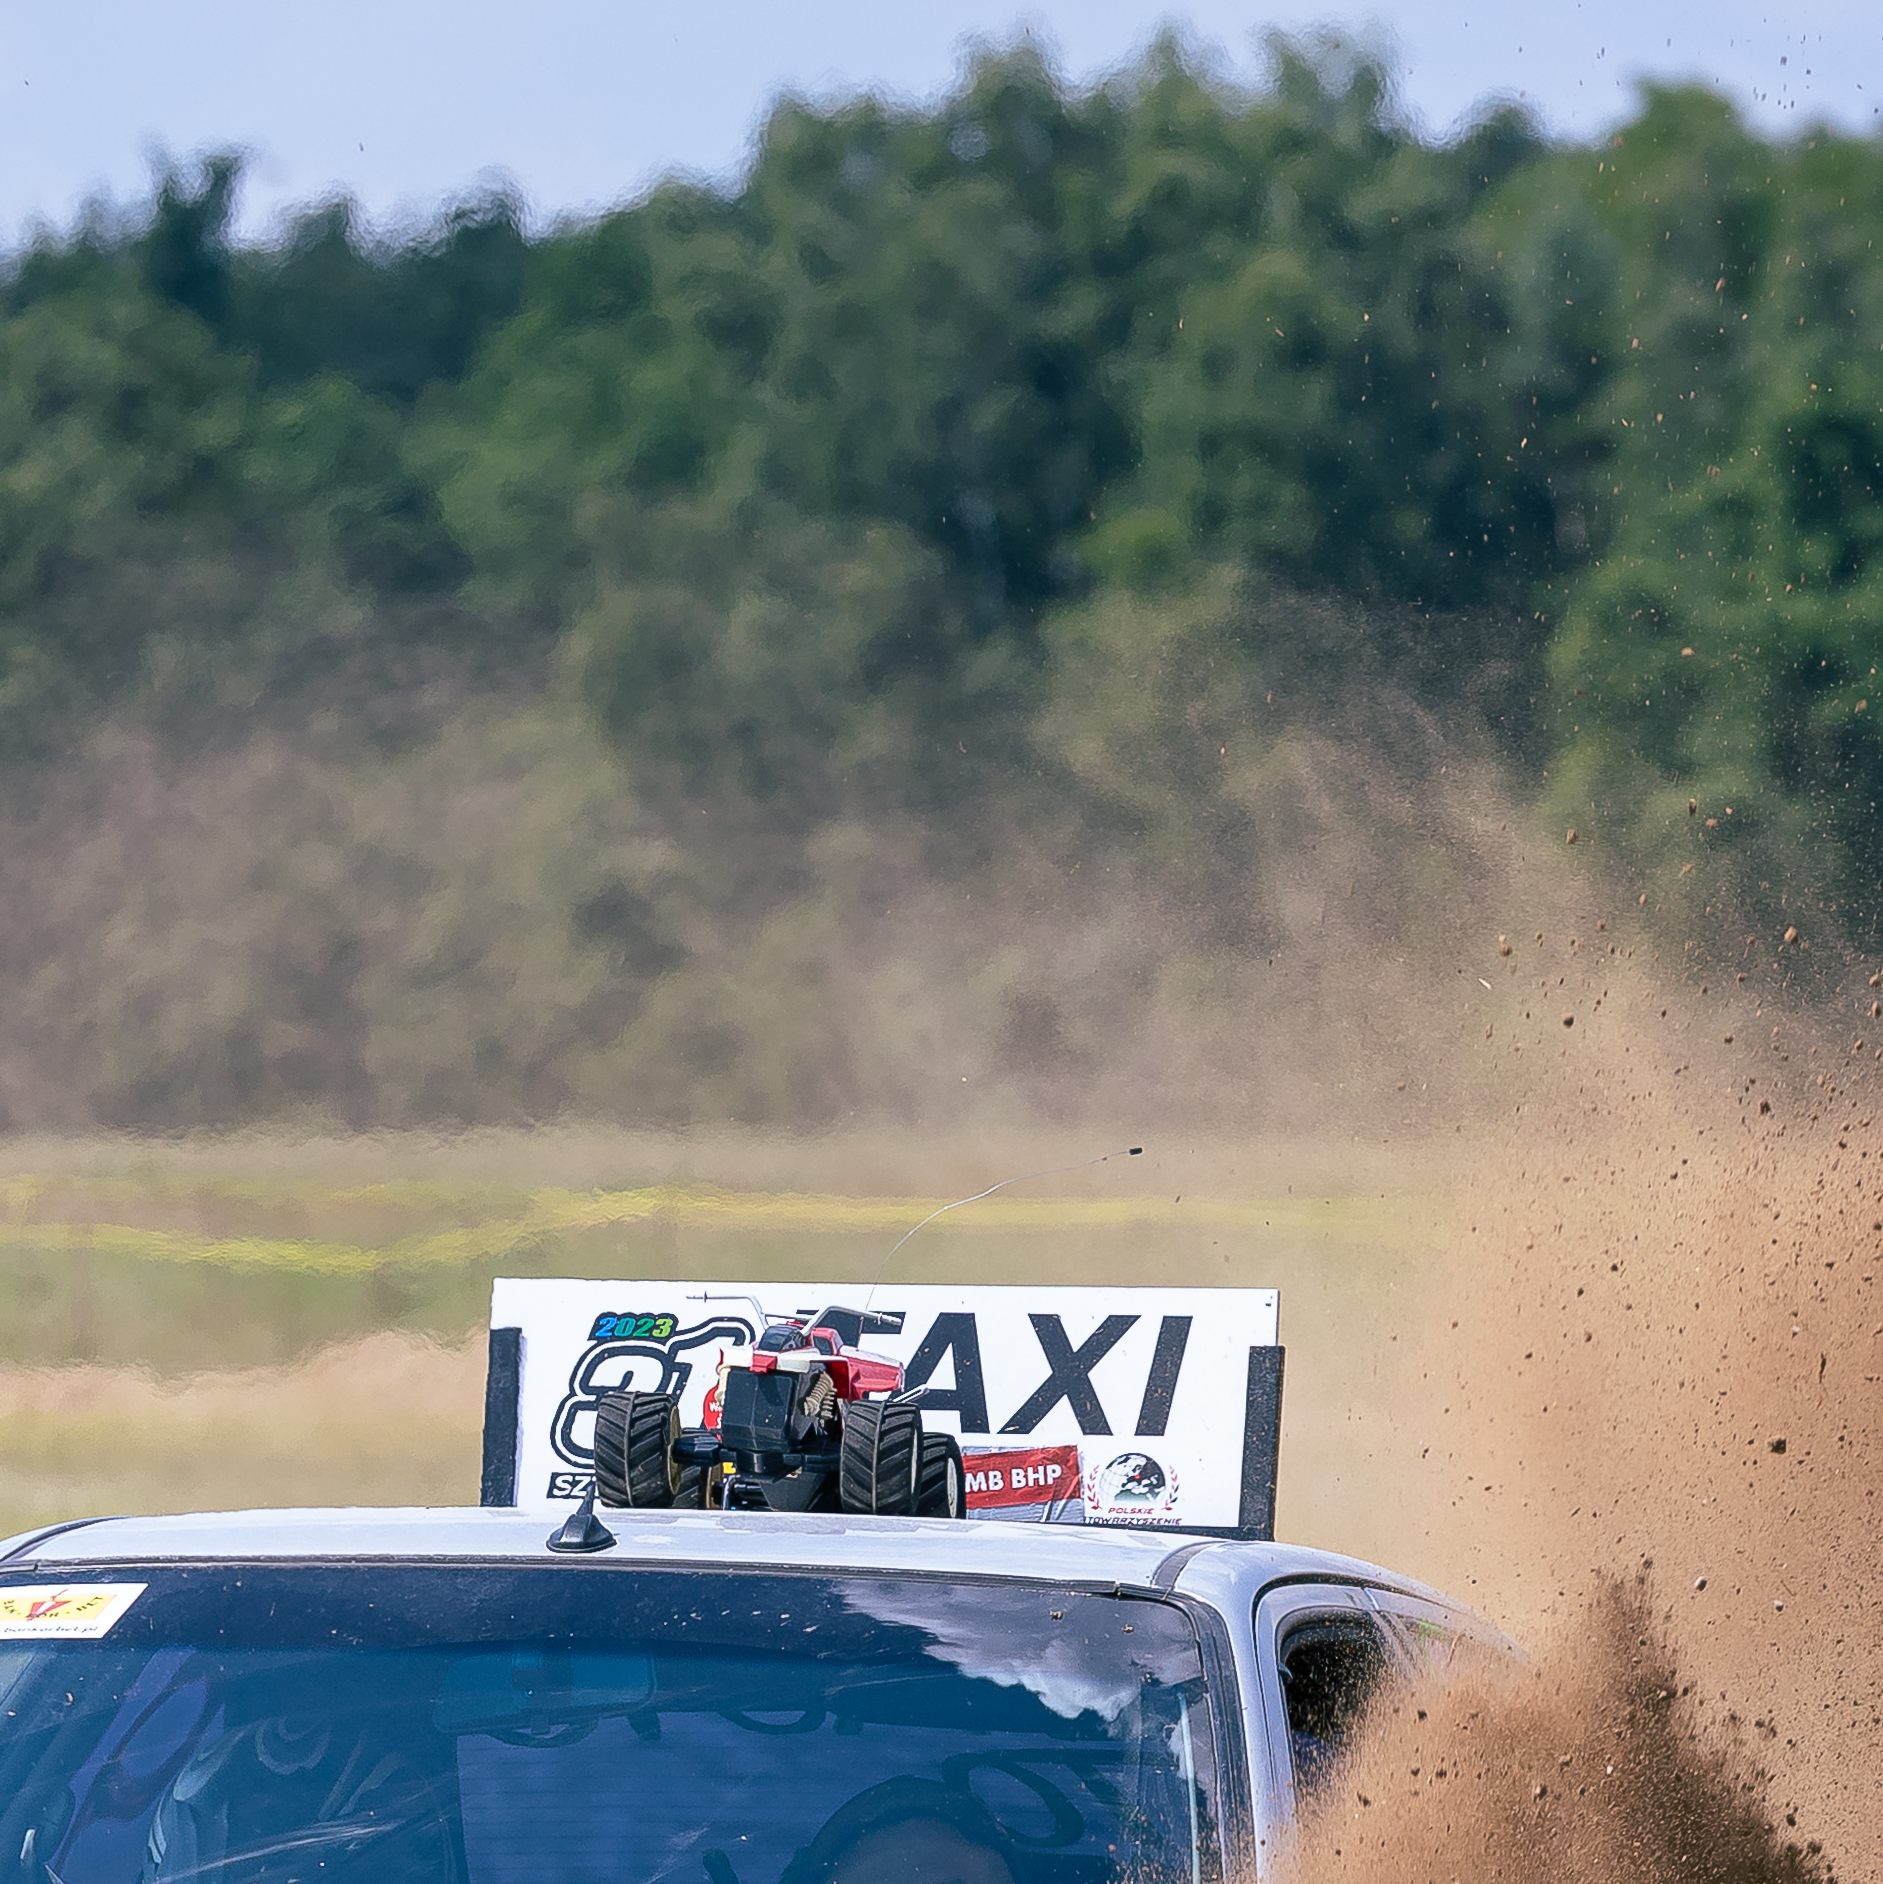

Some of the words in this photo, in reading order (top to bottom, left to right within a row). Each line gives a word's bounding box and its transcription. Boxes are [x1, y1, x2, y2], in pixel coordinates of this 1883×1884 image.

[594, 1316, 673, 1337] 2023
[552, 1474, 597, 1496] SZ
[1011, 1463, 1063, 1489] BHP
[1107, 1506, 1155, 1515] POLSKIE
